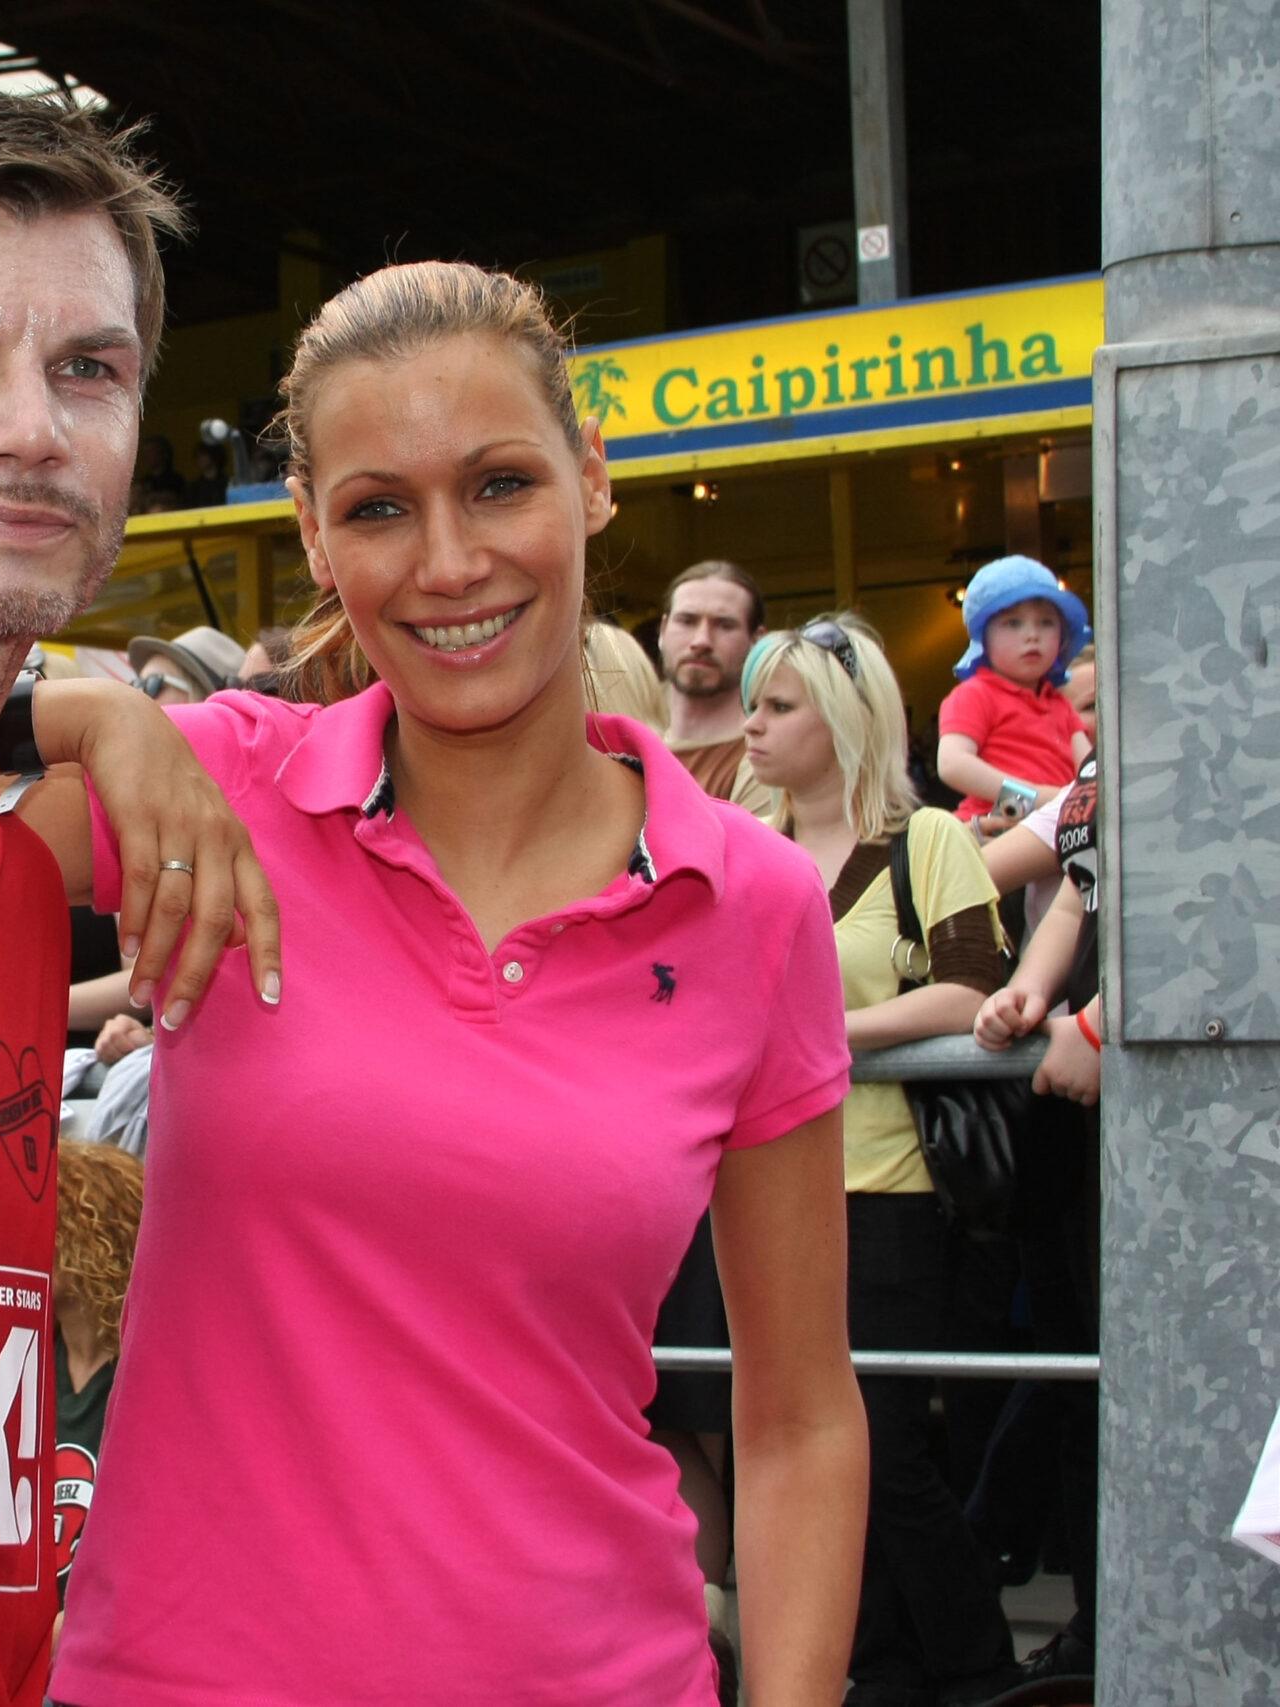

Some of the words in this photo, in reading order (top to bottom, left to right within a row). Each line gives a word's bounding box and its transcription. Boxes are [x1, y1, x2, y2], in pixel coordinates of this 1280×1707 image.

[652, 323, 1062, 425] Caipirinha
[1059, 825, 1088, 852] 2008
[16, 1291, 42, 1311] STARS
